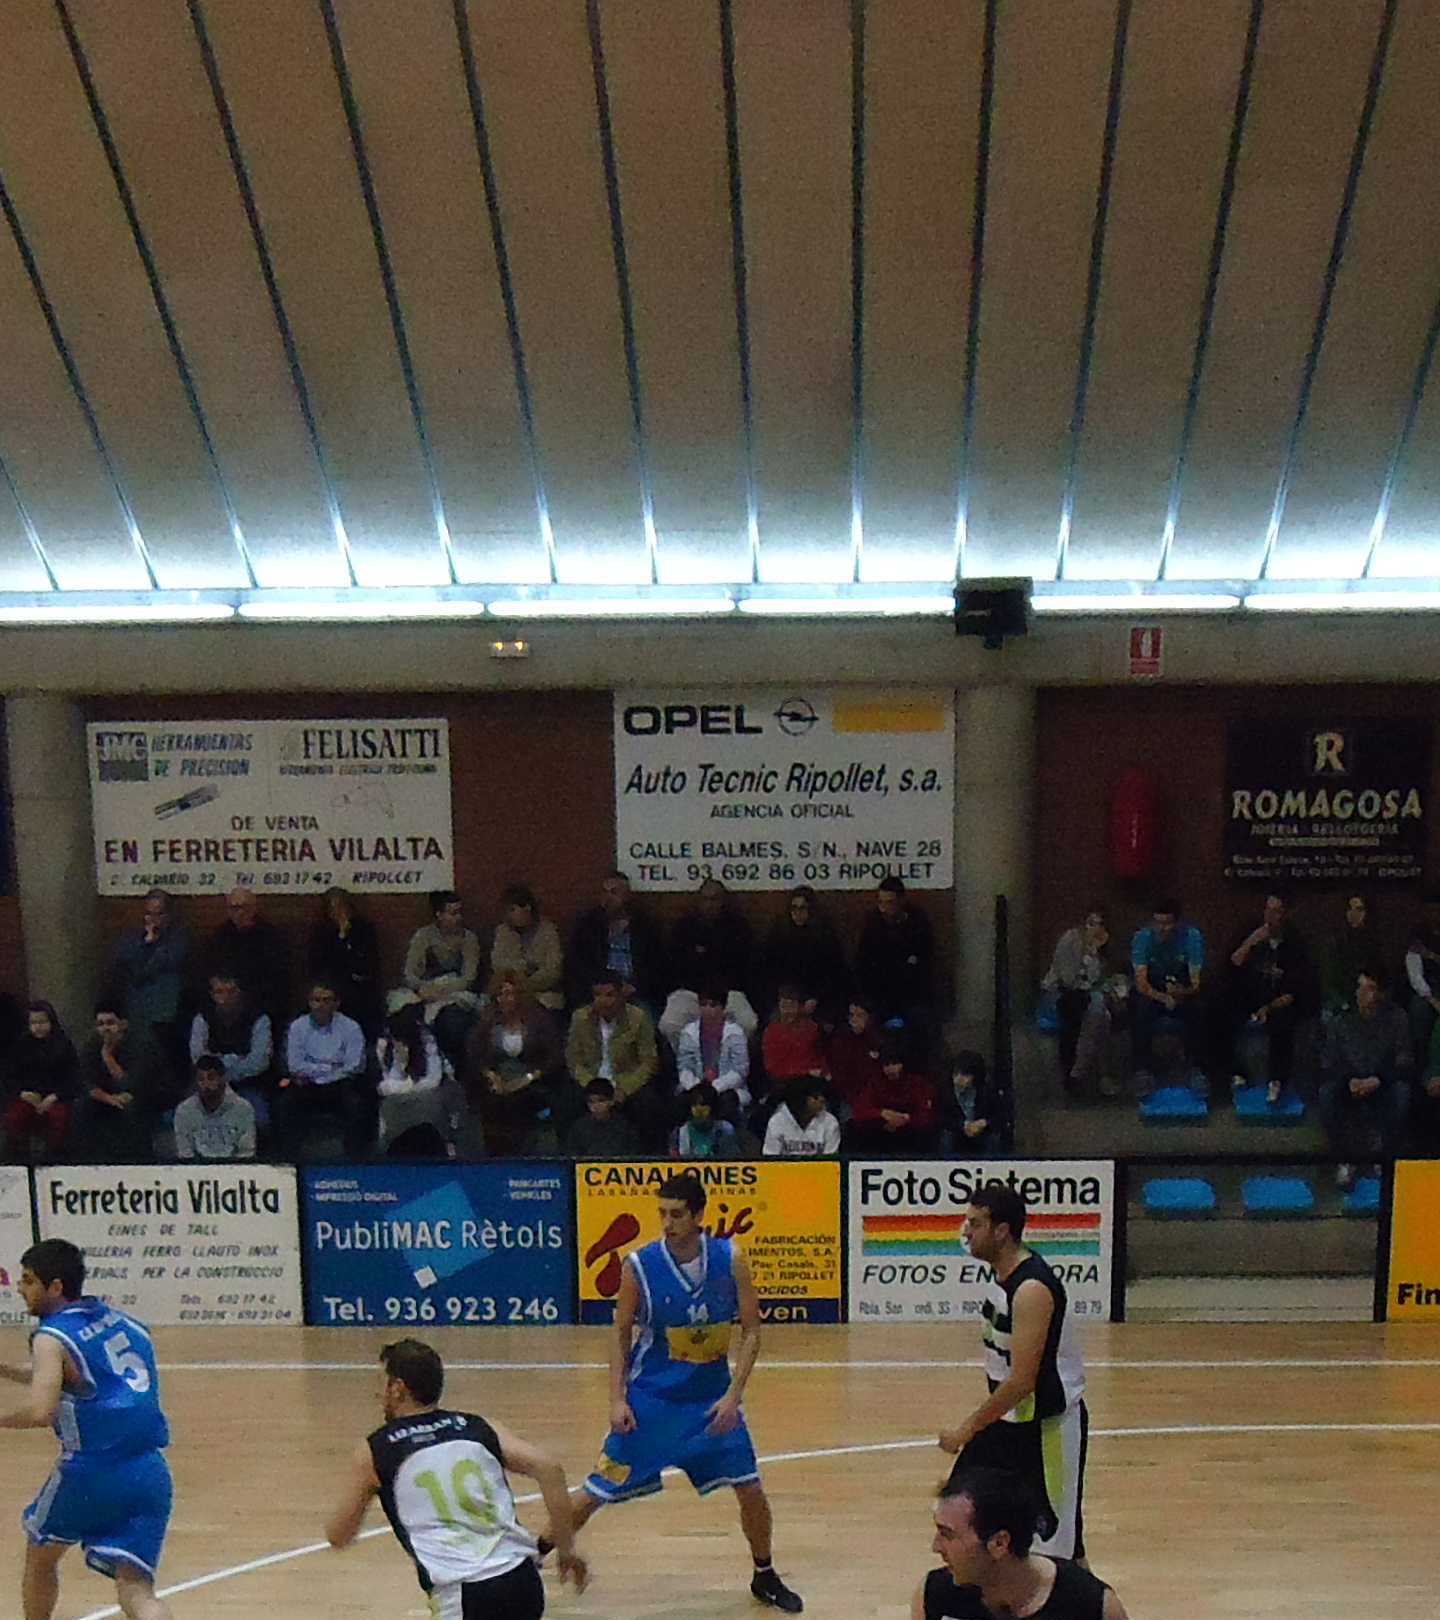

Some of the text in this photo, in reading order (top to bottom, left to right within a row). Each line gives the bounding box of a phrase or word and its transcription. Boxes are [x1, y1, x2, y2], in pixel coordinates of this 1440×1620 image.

[623, 704, 763, 736] OPEL
[302, 728, 442, 760] FELISATTI
[1313, 731, 1346, 773] R
[625, 762, 943, 800] Auto Tecnic Ripollet, s.a.
[710, 803, 855, 819] AGENCIA OFICIAL
[1231, 788, 1423, 821] ROMAGOSA
[231, 815, 319, 831] DE VENTA
[104, 836, 445, 863] EN FERRETERIA VILALTA
[629, 842, 692, 860] CALLE
[856, 841, 907, 858] NAVE
[916, 840, 942, 857] 28
[686, 864, 711, 881] 93
[721, 864, 760, 881] 692
[768, 864, 795, 880] 86
[803, 863, 831, 880] 03
[839, 863, 935, 880] RIPOLLET
[50, 1179, 280, 1214] Ferreteria Vilalta
[860, 1169, 941, 1205] Foto
[160, 1224, 176, 1236] DE
[315, 1218, 563, 1250] PubliMAC Rètols
[142, 1267, 166, 1279] PER
[862, 1264, 947, 1284] FOTOS
[959, 1265, 994, 1283] EN
[323, 1297, 559, 1322] Tel. 936 923 246
[103, 1330, 151, 1393] 5
[413, 1457, 499, 1531] 10
